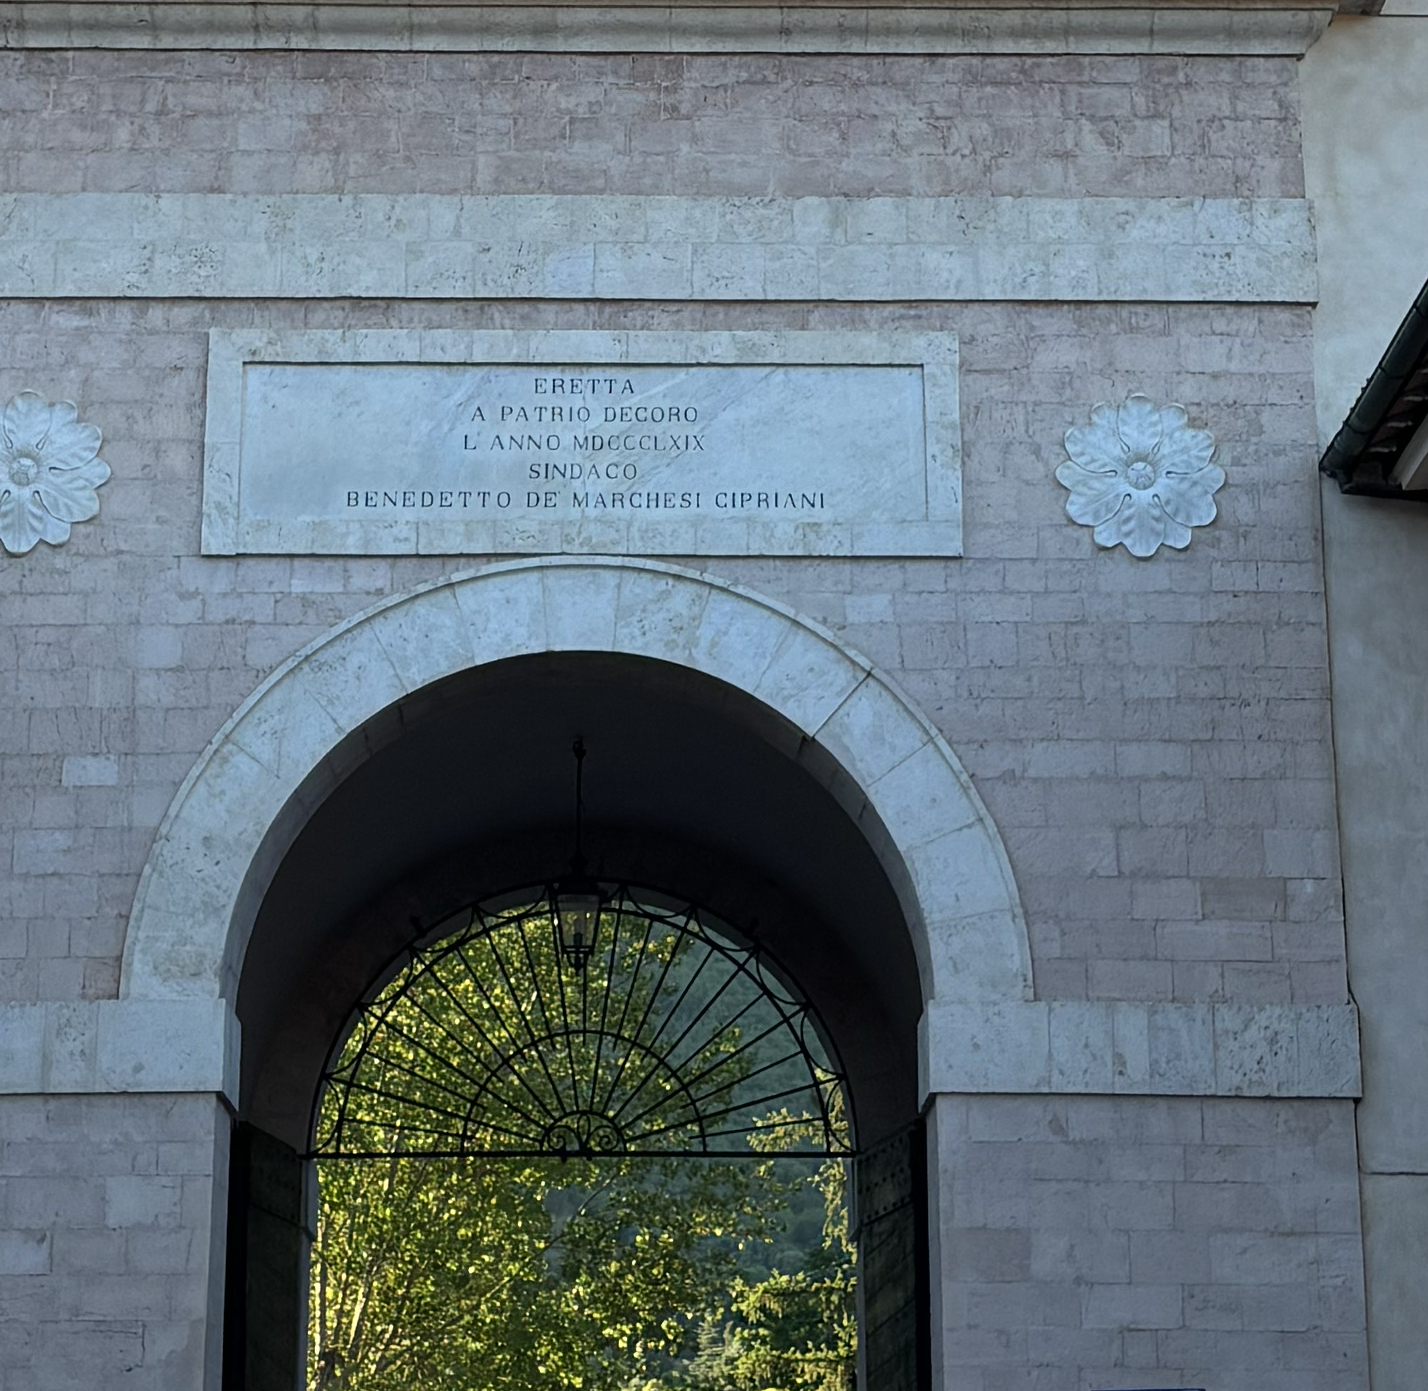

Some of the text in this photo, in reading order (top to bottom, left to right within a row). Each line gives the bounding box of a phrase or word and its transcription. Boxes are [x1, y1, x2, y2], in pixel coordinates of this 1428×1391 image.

[534, 377, 635, 395] ERETTA
[471, 406, 698, 423] A PATRIO DECORO
[490, 434, 561, 451] ANNO
[572, 434, 705, 452] MDCCCLXIX
[528, 463, 638, 480] SINDACO
[346, 490, 825, 509] BENEDETTO DE' MARCHESI CIPRIANI
